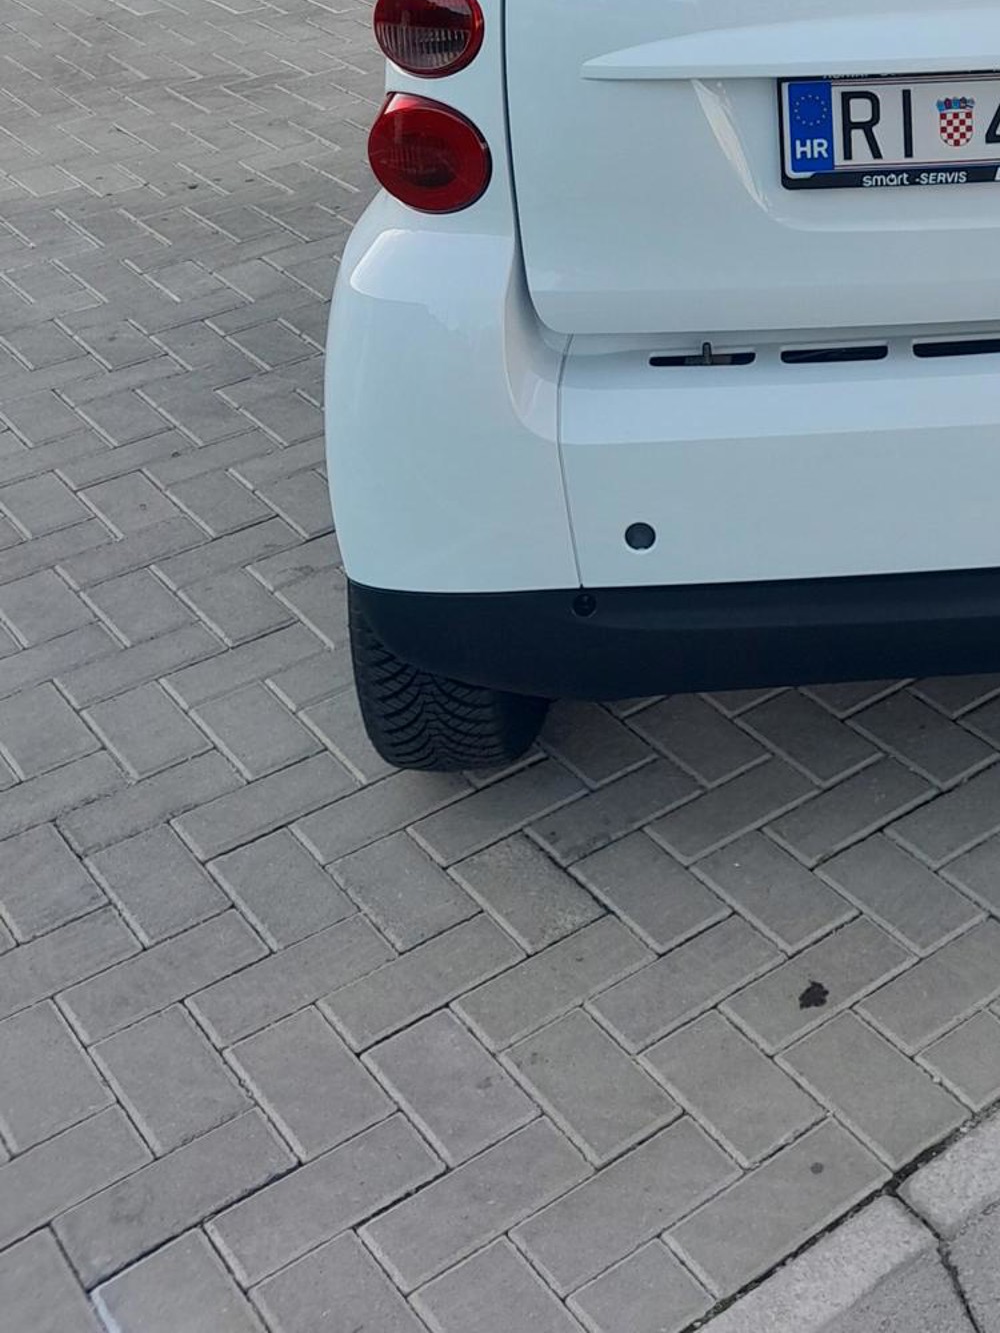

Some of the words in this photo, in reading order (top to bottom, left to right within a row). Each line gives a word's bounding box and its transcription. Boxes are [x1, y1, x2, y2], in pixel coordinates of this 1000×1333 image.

[840, 88, 913, 160] RI
[795, 139, 828, 159] HR
[862, 170, 909, 187] smart
